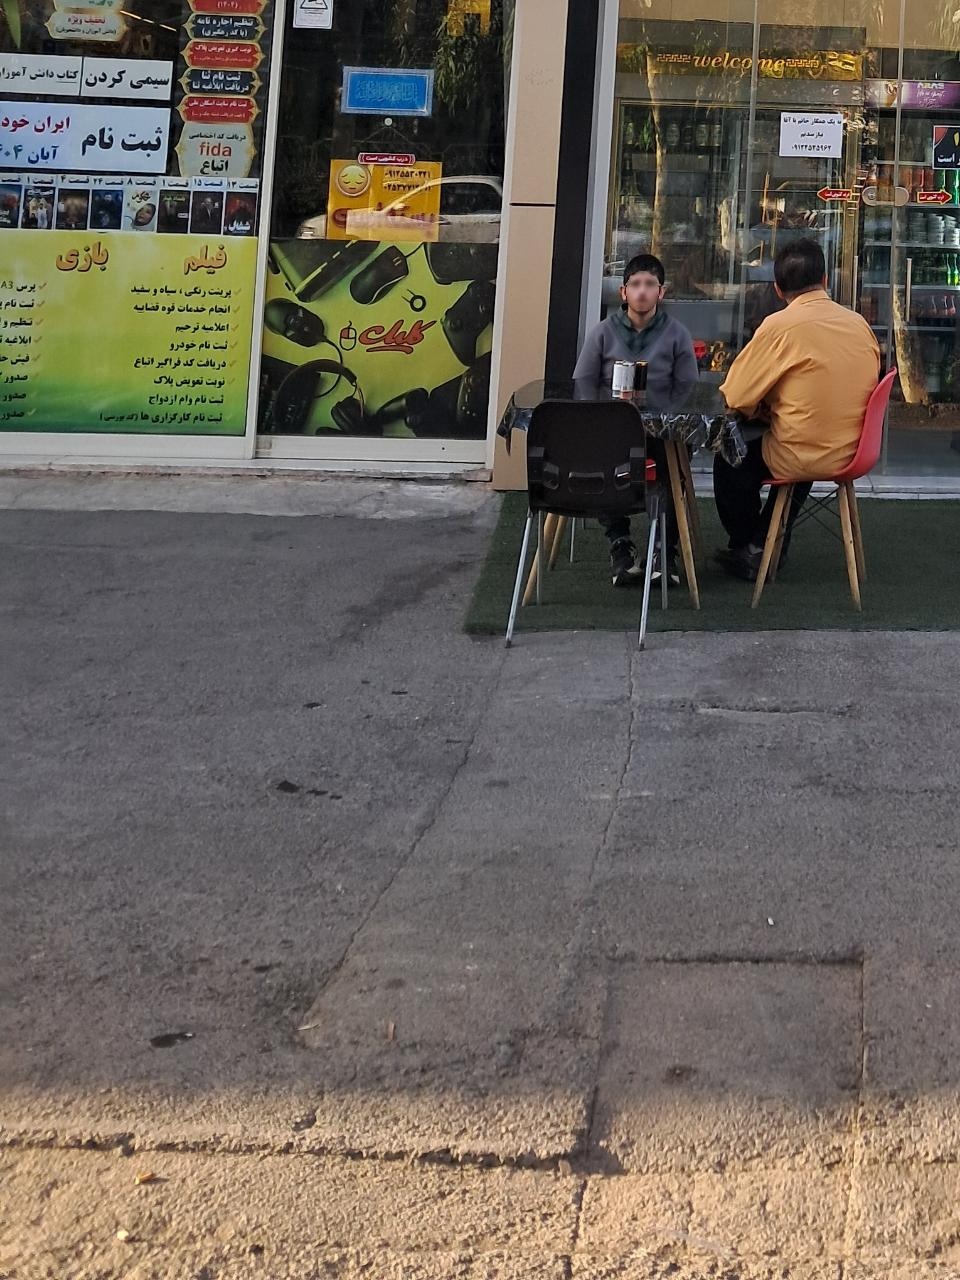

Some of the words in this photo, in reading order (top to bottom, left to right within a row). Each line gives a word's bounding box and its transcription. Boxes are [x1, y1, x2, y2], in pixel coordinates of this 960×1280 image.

[693, 52, 786, 72] welcome
[29, 68, 55, 80] دانش
[56, 70, 79, 79] کتاب
[84, 69, 127, 88] کردن
[129, 76, 170, 89] سیمی
[33, 115, 71, 134] ایران
[81, 126, 114, 157] نام
[120, 126, 163, 158] ثبت
[27, 144, 59, 165] آبان
[199, 141, 232, 157] fida
[937, 152, 956, 163] است
[199, 159, 229, 175] اتباع
[56, 241, 109, 272] بازی
[183, 243, 228, 276] فیلم
[0, 280, 14, 290] A3
[208, 287, 232, 299] پرینت
[177, 304, 206, 314] خدمات
[208, 304, 231, 316] انجام
[169, 340, 197, 351] خودرو
[198, 340, 211, 351] نام
[212, 340, 228, 350] ثبت
[183, 358, 195, 367] کد
[196, 359, 227, 370] دریافت
[205, 378, 225, 388] نوبت
[178, 394, 193, 406] وام
[194, 394, 207, 406] نام
[208, 394, 224, 405] ثبت
